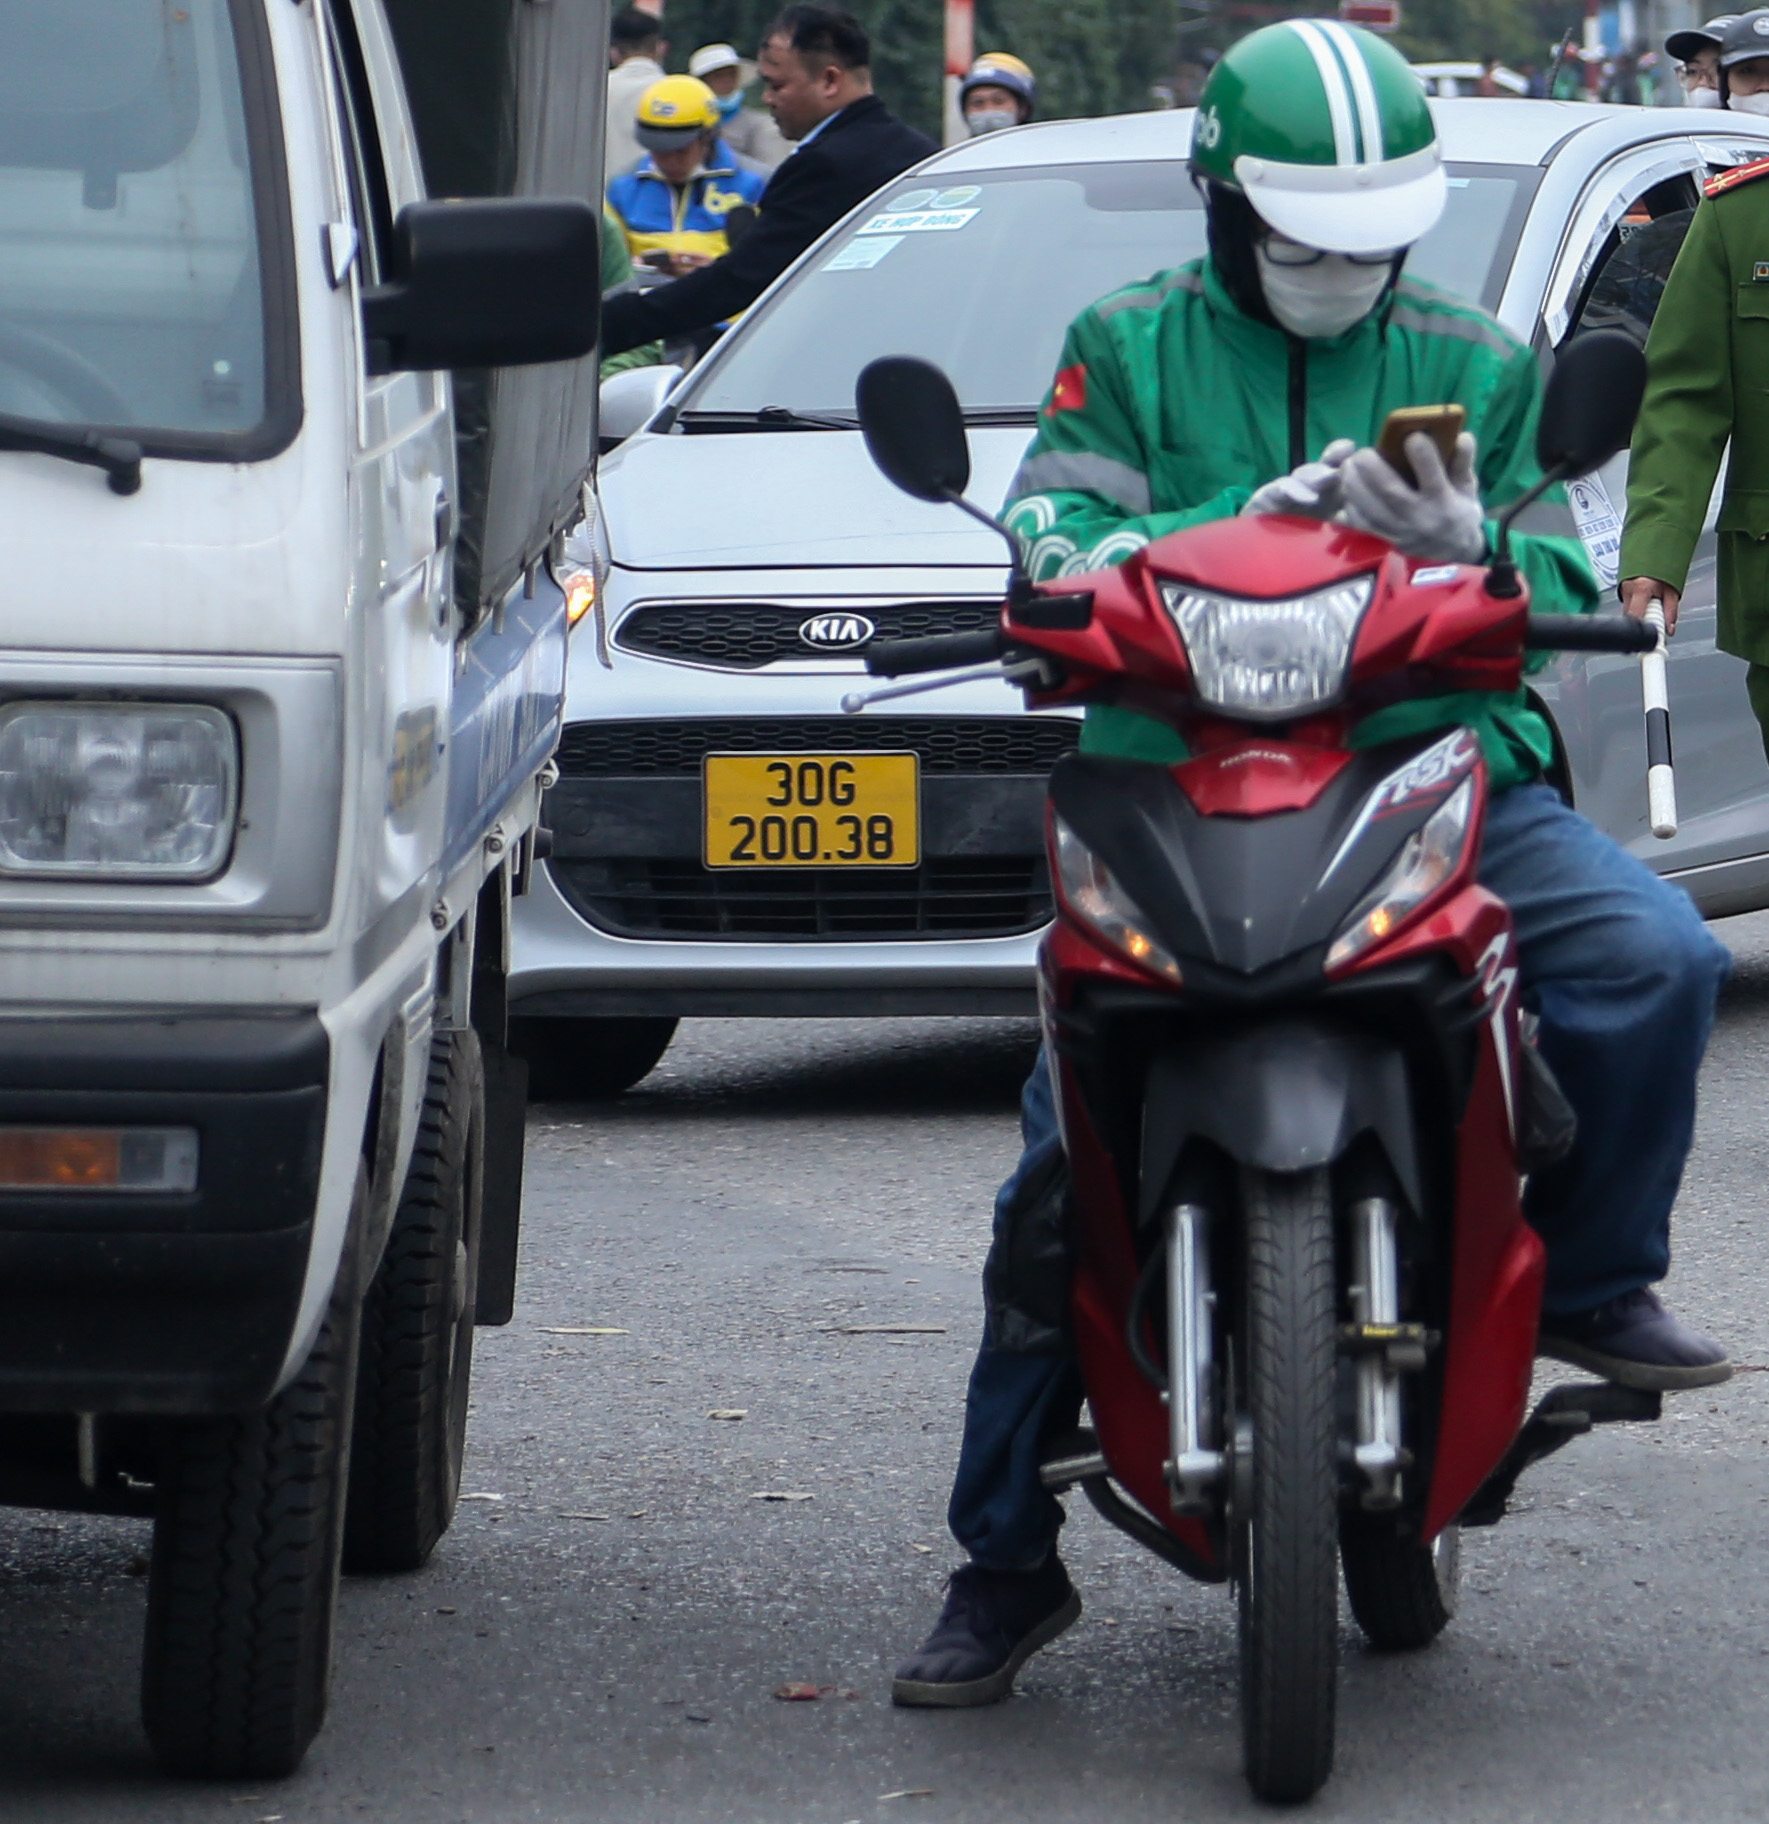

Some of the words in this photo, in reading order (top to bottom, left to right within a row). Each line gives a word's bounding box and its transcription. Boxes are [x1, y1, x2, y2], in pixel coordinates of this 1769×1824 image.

[808, 618, 861, 641] KIA
[766, 761, 856, 807] 30G
[729, 814, 894, 861] 200.38
